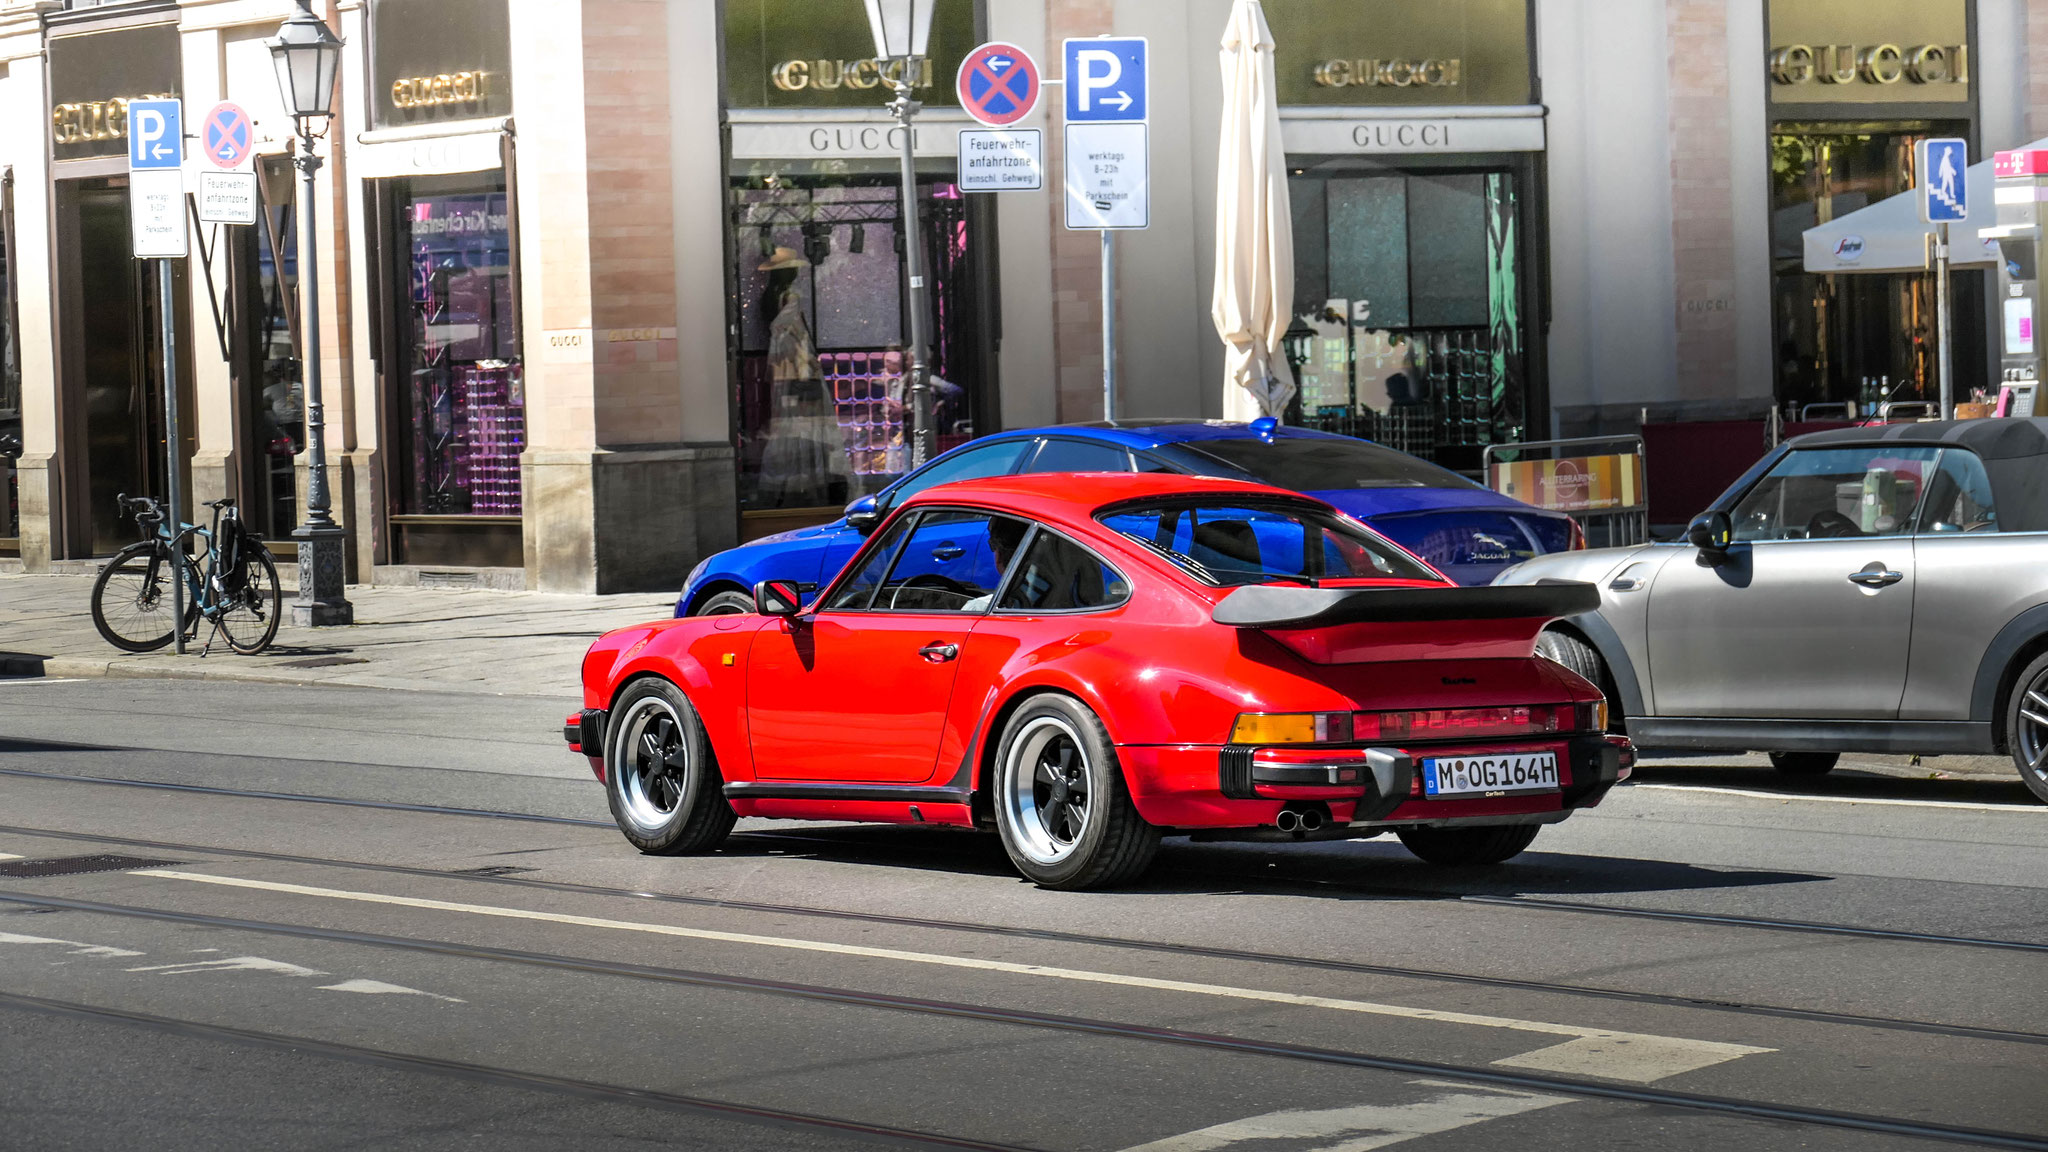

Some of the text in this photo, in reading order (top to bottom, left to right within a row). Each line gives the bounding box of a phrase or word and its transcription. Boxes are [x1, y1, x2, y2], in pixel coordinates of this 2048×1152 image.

[1772, 44, 1968, 84] GUCCI
[1315, 59, 1460, 87] GUCCI
[1078, 50, 1122, 111] P
[392, 72, 488, 108] GUCCI
[136, 109, 166, 160] P
[810, 127, 918, 151] GUCCI
[1352, 125, 1449, 147] GUCCI
[971, 138, 1032, 150] Feuerwehr-
[969, 155, 1031, 168] anfahrtzone
[1088, 152, 1125, 163] werktags
[207, 177, 249, 189] Feuerwehr-
[1100, 178, 1113, 187] mit
[206, 193, 248, 204] anfahrtzone
[1085, 191, 1129, 200] Parkschein
[550, 335, 582, 347] GUCCI
[1470, 552, 1511, 561] JAGUAR
[1438, 762, 1454, 789] M
[1428, 780, 1435, 788] D
